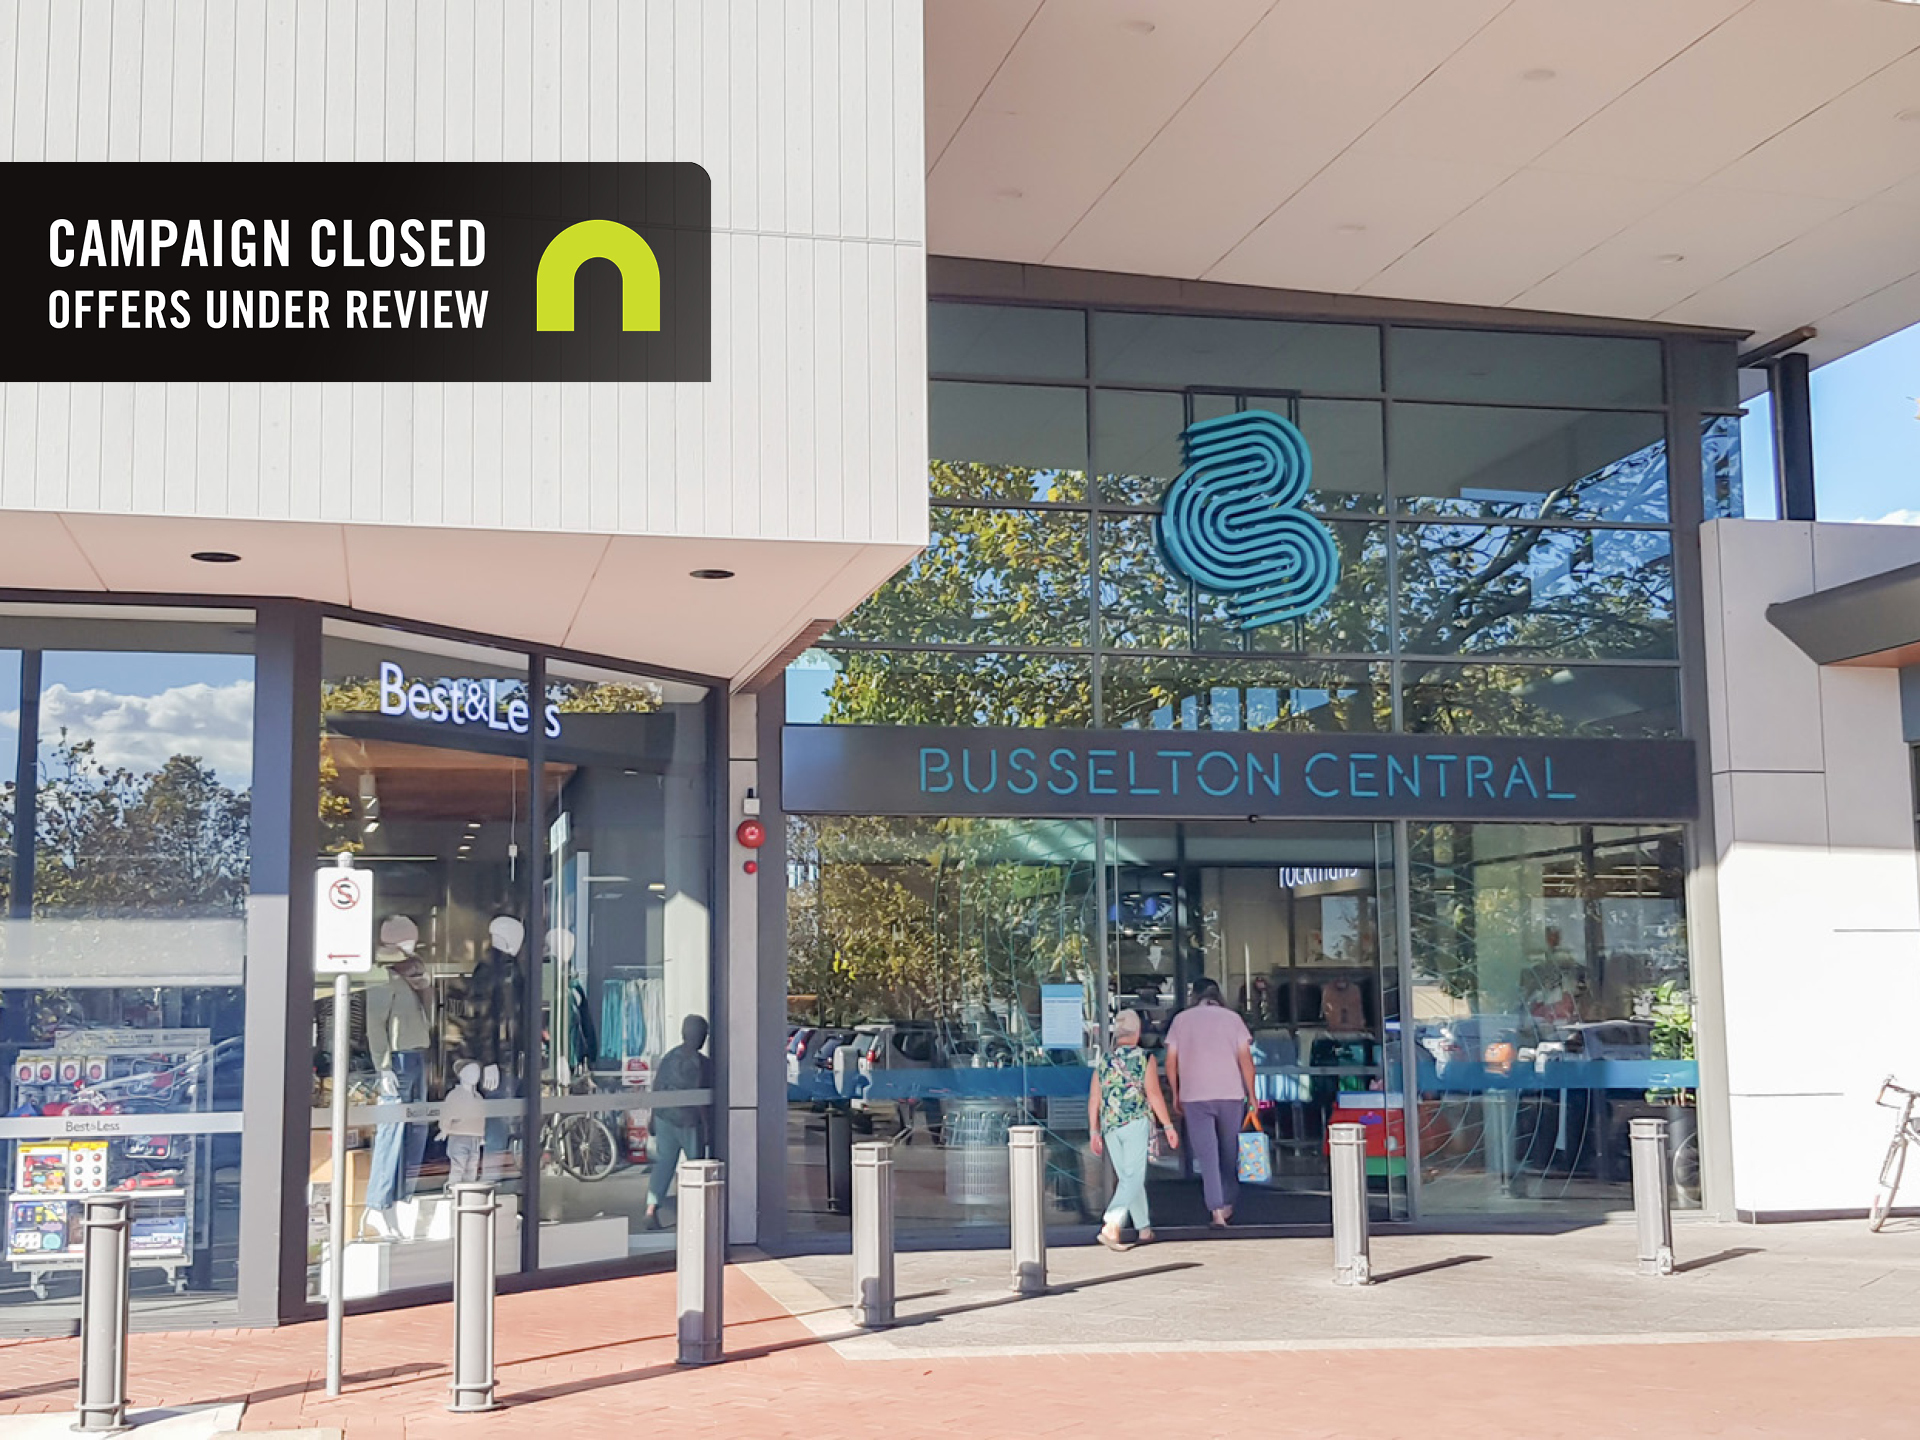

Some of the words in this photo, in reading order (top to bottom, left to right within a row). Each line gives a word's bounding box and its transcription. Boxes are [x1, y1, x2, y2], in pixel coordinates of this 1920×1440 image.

[379, 660, 561, 738] Best&Les
[919, 747, 1282, 796] BUSSELTON
[1305, 752, 1577, 799] CENTRAL
